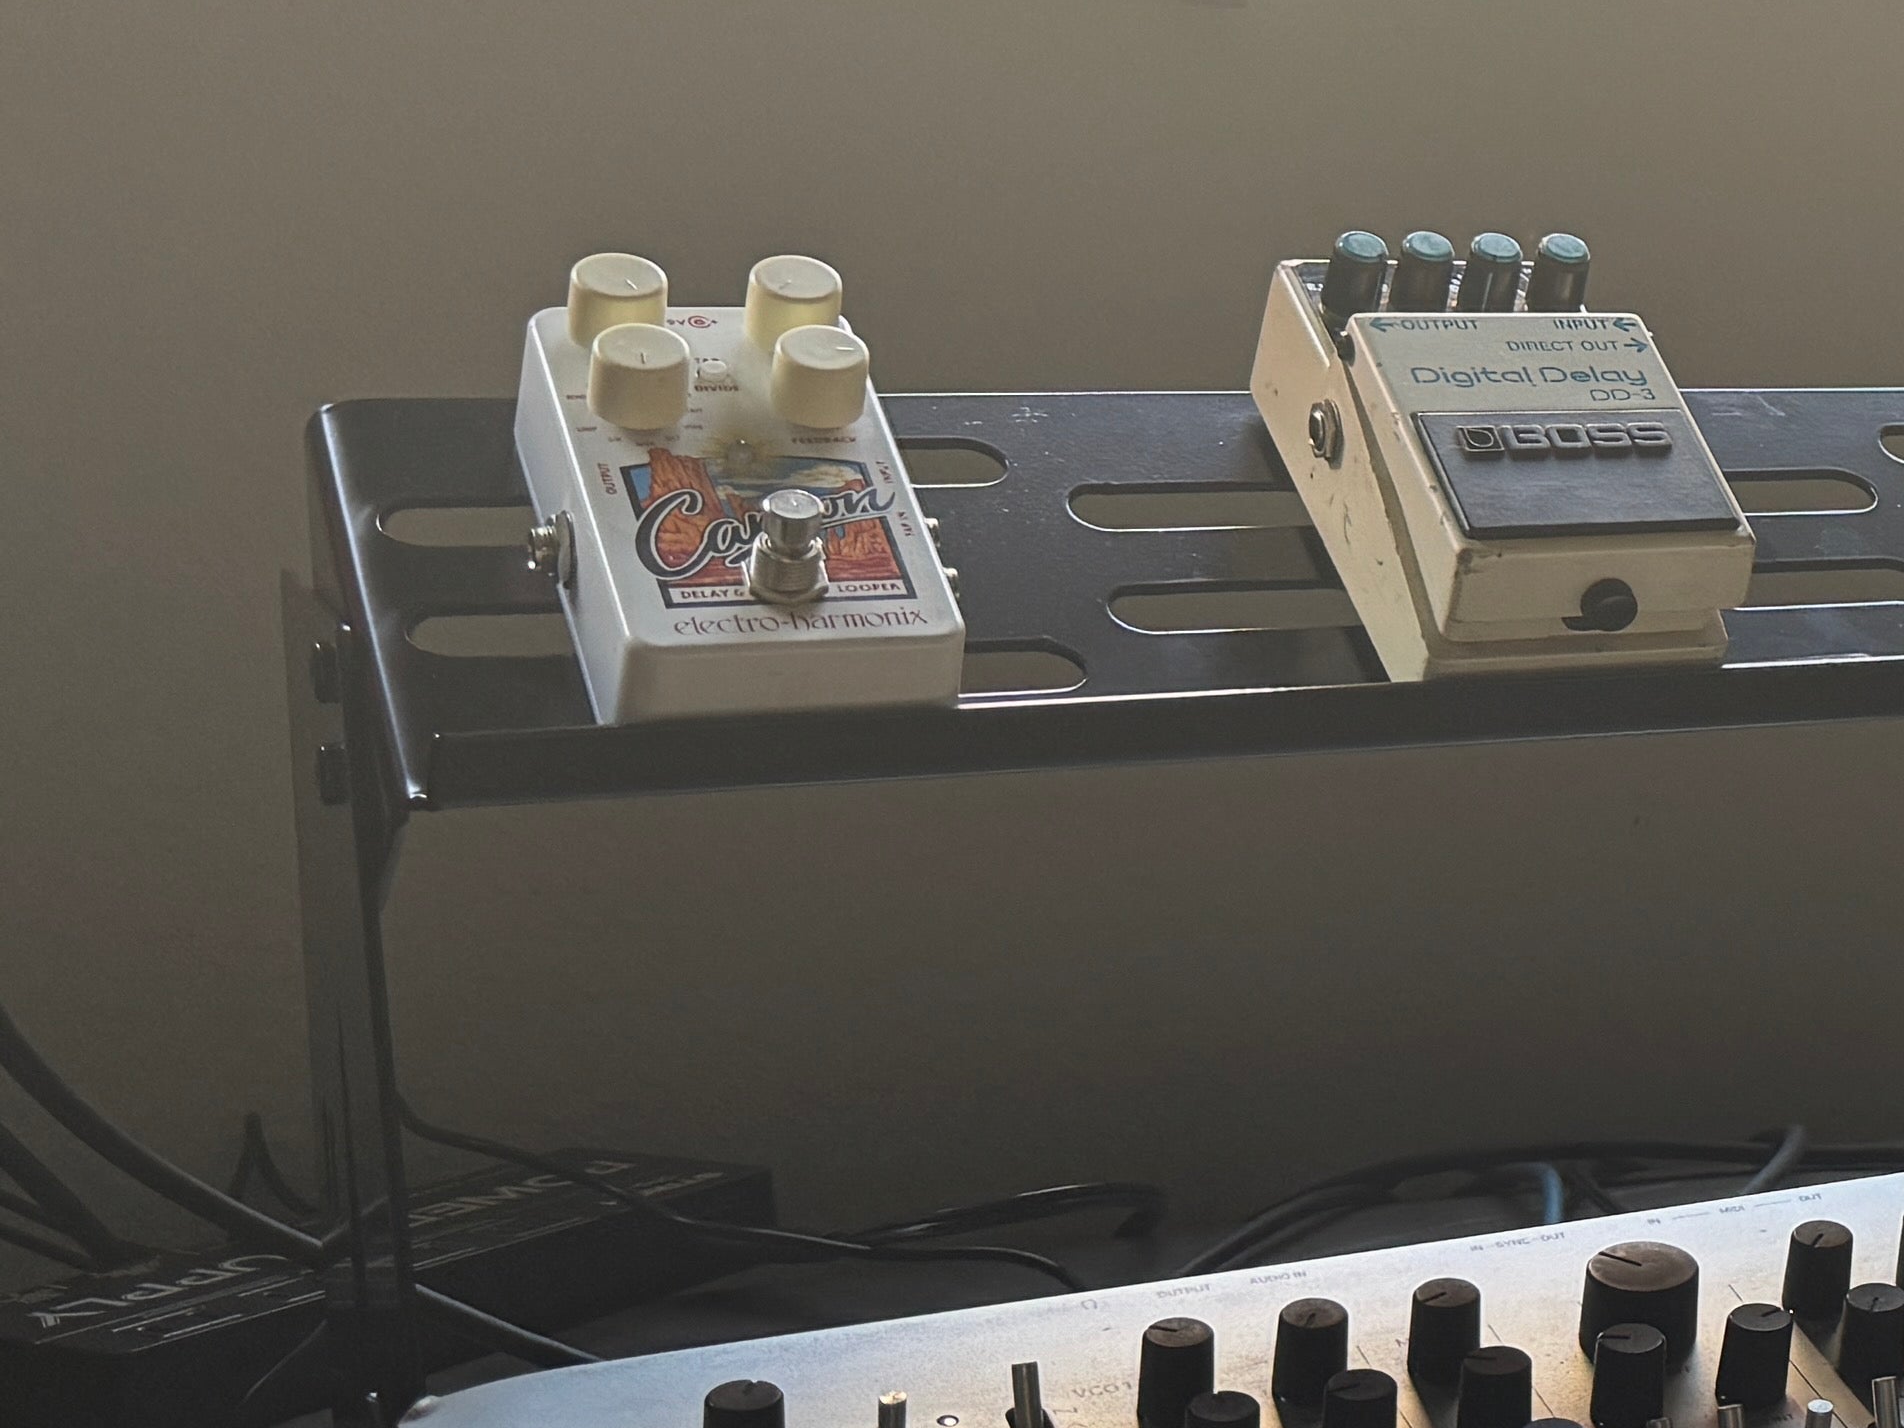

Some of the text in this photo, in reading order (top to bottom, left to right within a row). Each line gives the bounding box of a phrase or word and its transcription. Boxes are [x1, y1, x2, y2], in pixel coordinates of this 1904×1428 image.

[1401, 318, 1480, 331] OUTPUT
[1553, 318, 1610, 330] INPUT
[1506, 339, 1620, 353] DIRECT OUT
[1410, 364, 1649, 389] Digital Delay
[1590, 388, 1657, 403] DD-3
[1501, 421, 1674, 451] BOSS
[597, 462, 618, 496] OUTPUT
[634, 486, 896, 581] Caon
[680, 588, 729, 600] DELAY
[836, 582, 902, 594] LOOPER
[673, 606, 929, 636] electro-harmonix
